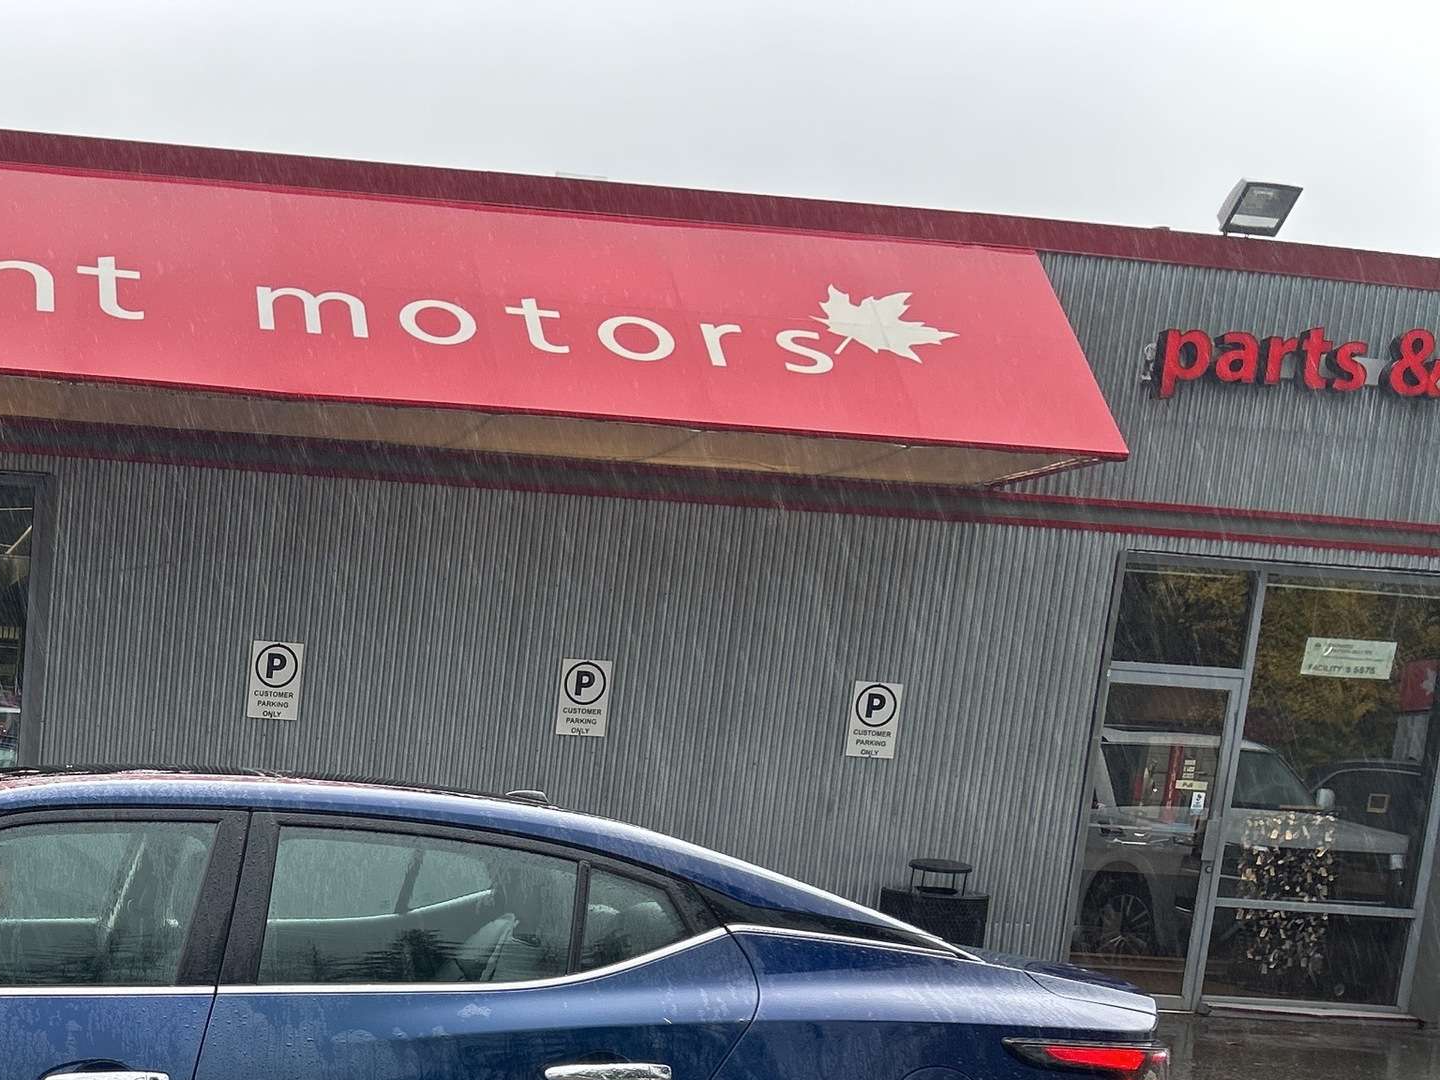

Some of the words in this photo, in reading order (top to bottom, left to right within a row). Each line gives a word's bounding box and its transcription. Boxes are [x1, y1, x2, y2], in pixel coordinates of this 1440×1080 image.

[256, 285, 836, 375] motors
[1159, 326, 1367, 399] parts
[1390, 328, 1440, 396] &
[266, 653, 287, 678] P
[575, 671, 595, 696] P
[254, 690, 294, 698] CUSTOMER
[257, 700, 289, 708] PARKING
[865, 693, 886, 718] P
[262, 710, 281, 718] ONLY
[562, 707, 602, 715] CUSTOMER
[566, 717, 597, 725] PARKING
[571, 727, 590, 735] ONLY
[853, 729, 891, 737] CUSTOMER
[855, 739, 886, 747] PARKING
